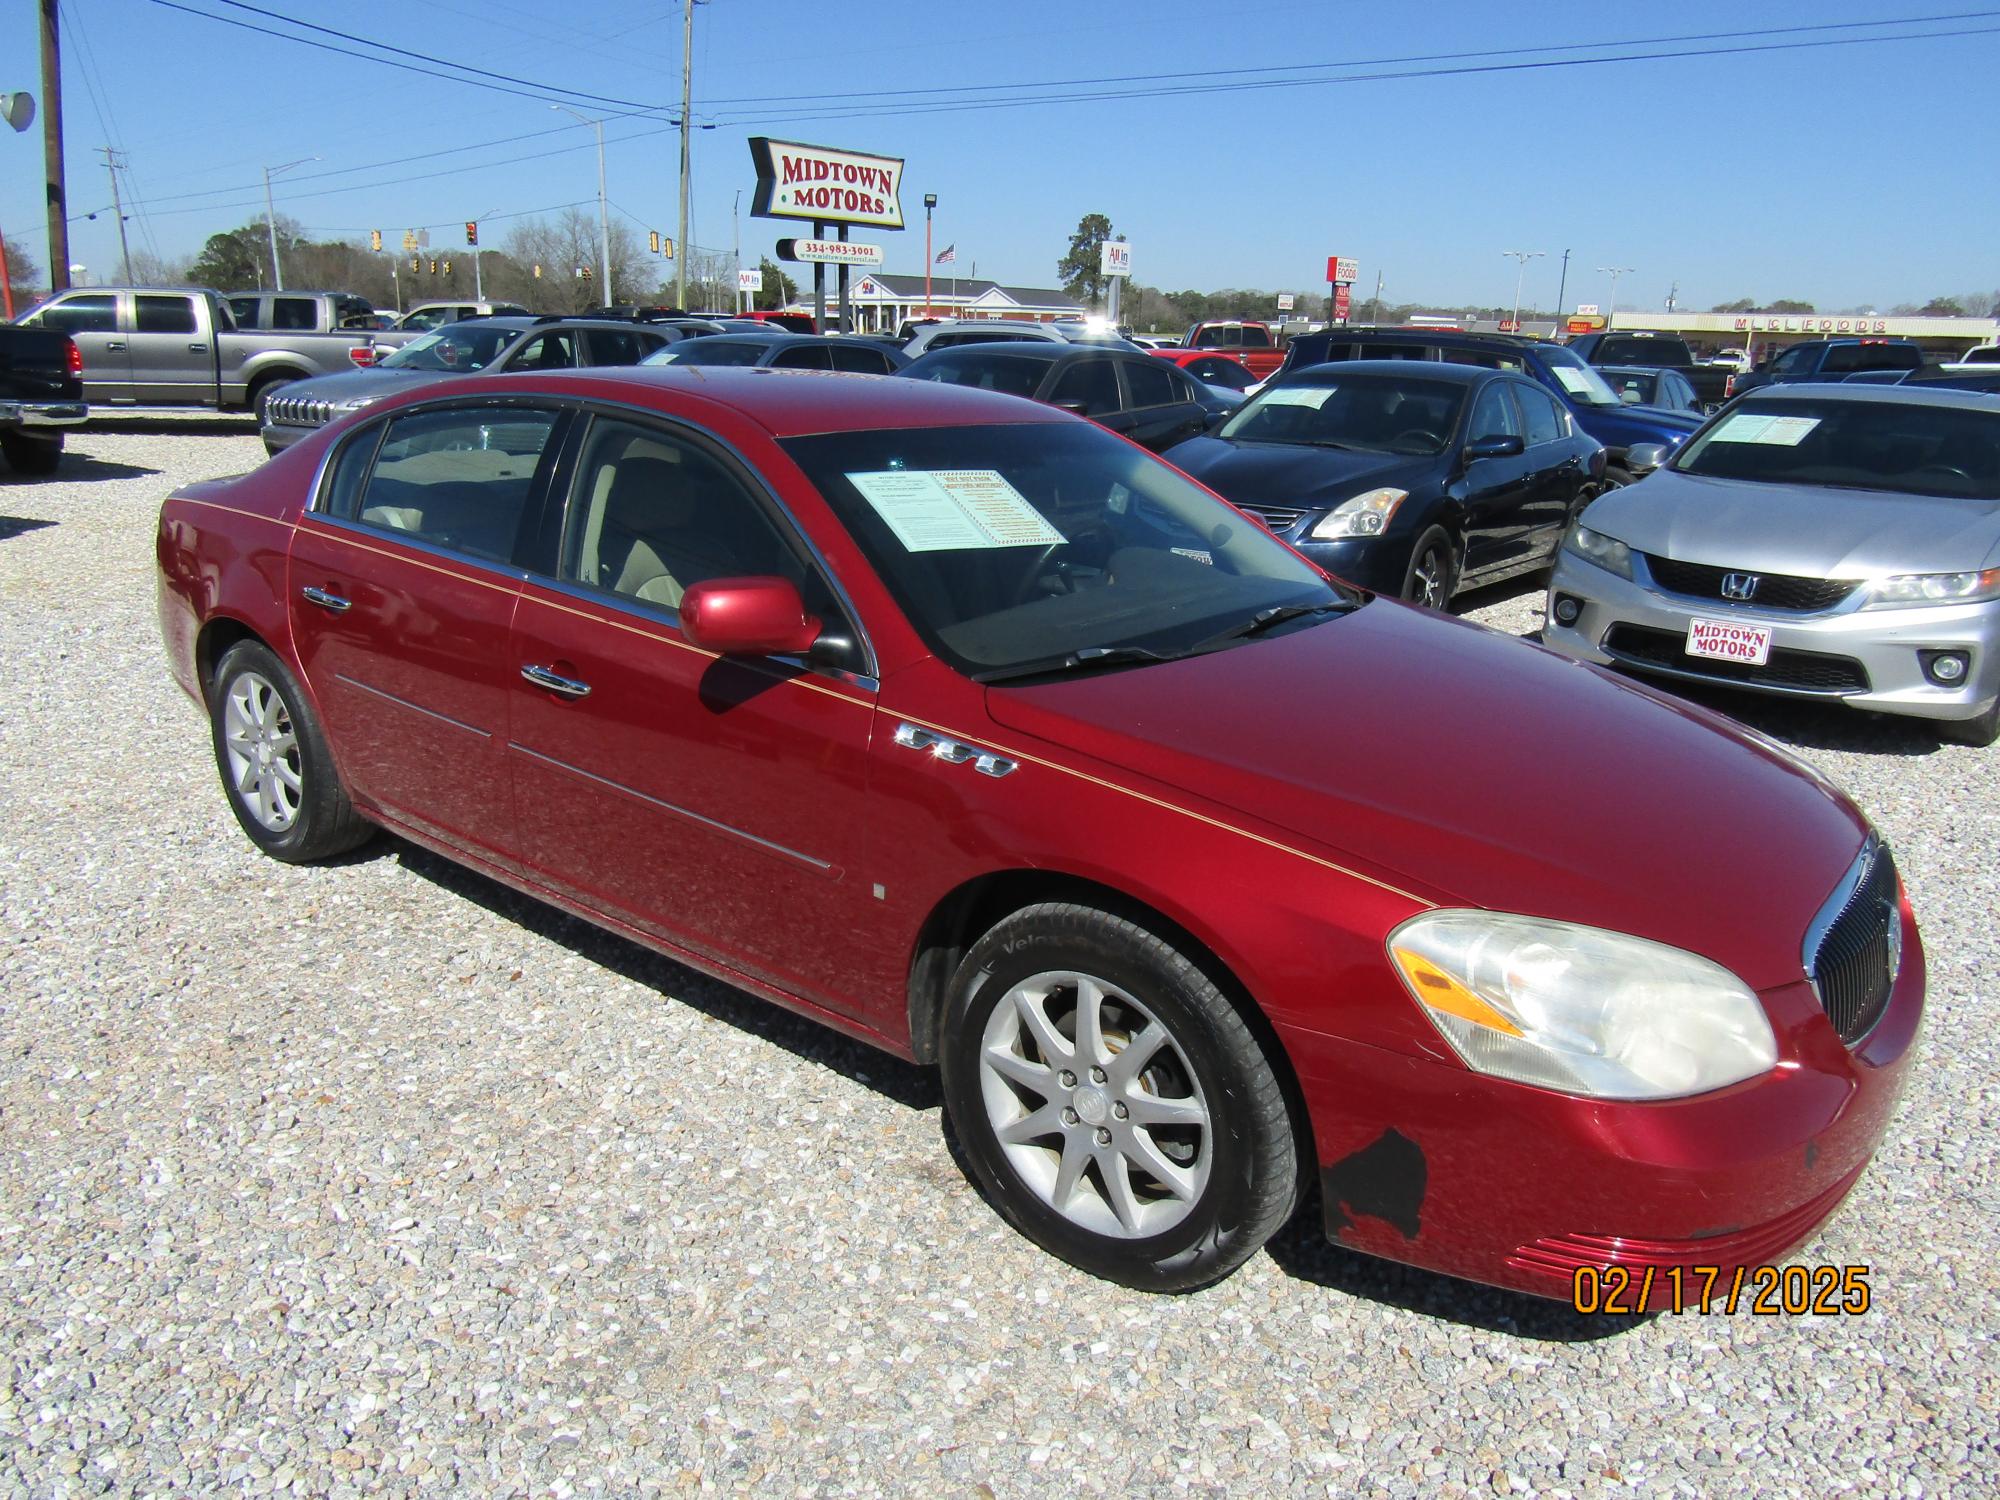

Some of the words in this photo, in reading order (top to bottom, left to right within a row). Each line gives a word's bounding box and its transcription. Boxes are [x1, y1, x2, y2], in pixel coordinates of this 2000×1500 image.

[782, 155, 893, 198] MIDTOWN
[793, 187, 885, 215] MOTORS
[1109, 247, 1119, 264] All
[1338, 268, 1356, 279] FOODS
[1804, 319, 1886, 331] FOODS
[1693, 624, 1766, 648] MIDTOWN
[1696, 639, 1757, 657] MOTORS
